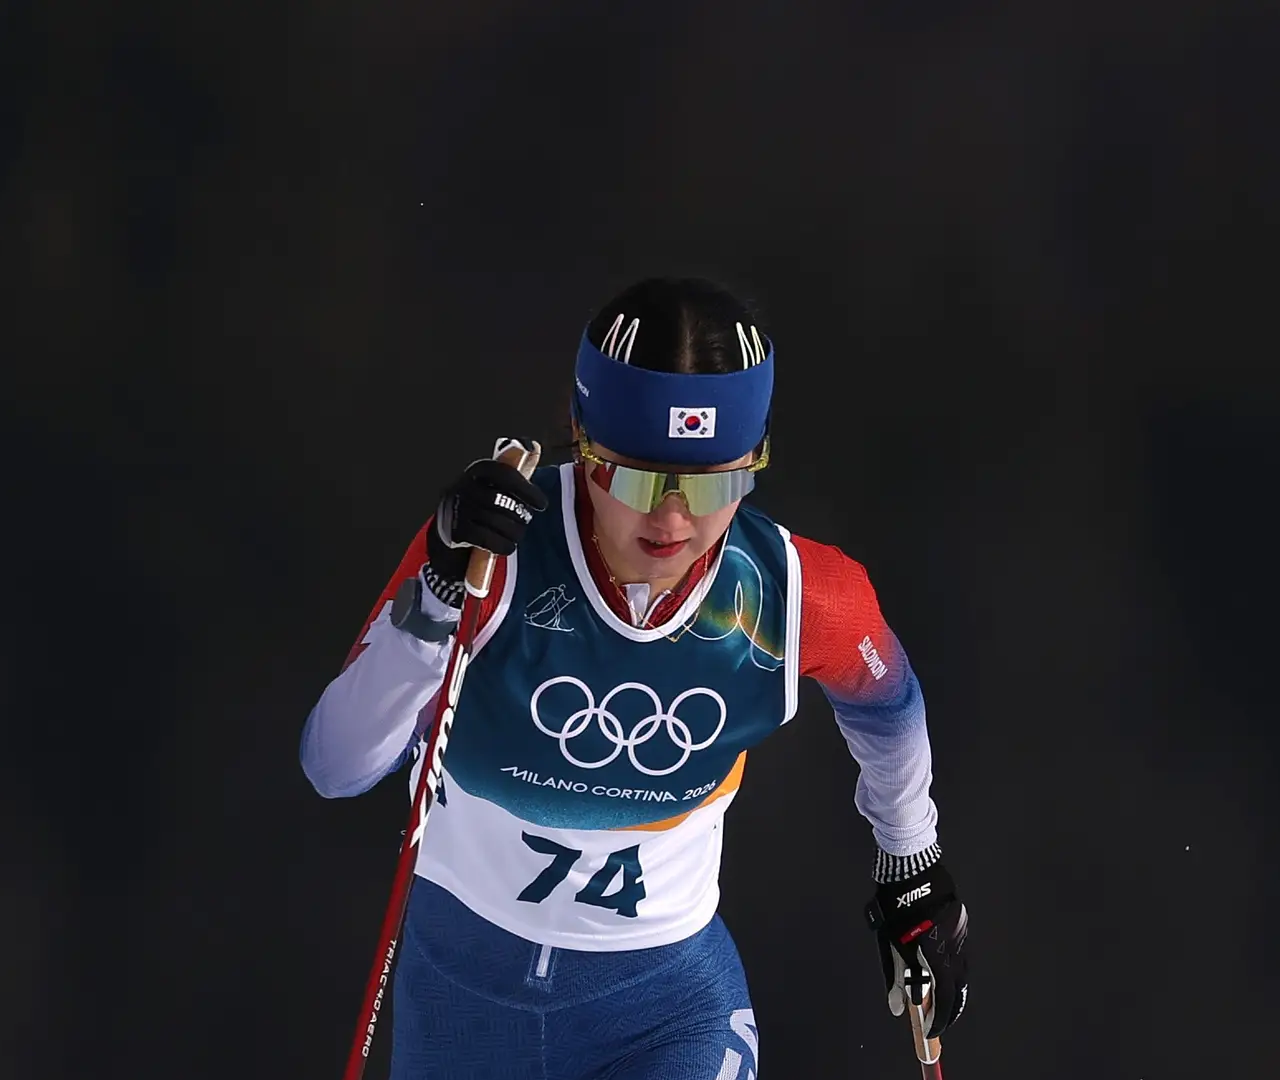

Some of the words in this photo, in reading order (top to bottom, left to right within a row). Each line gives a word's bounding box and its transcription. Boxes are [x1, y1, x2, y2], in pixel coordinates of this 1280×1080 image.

[858, 635, 888, 680] SALOMON
[500, 766, 588, 793] MILANO
[591, 785, 678, 802] CORTINA
[682, 779, 717, 800] 2026
[516, 830, 646, 918] 74
[380, 939, 397, 986] TRIAC
[362, 1011, 378, 1058] AERO
